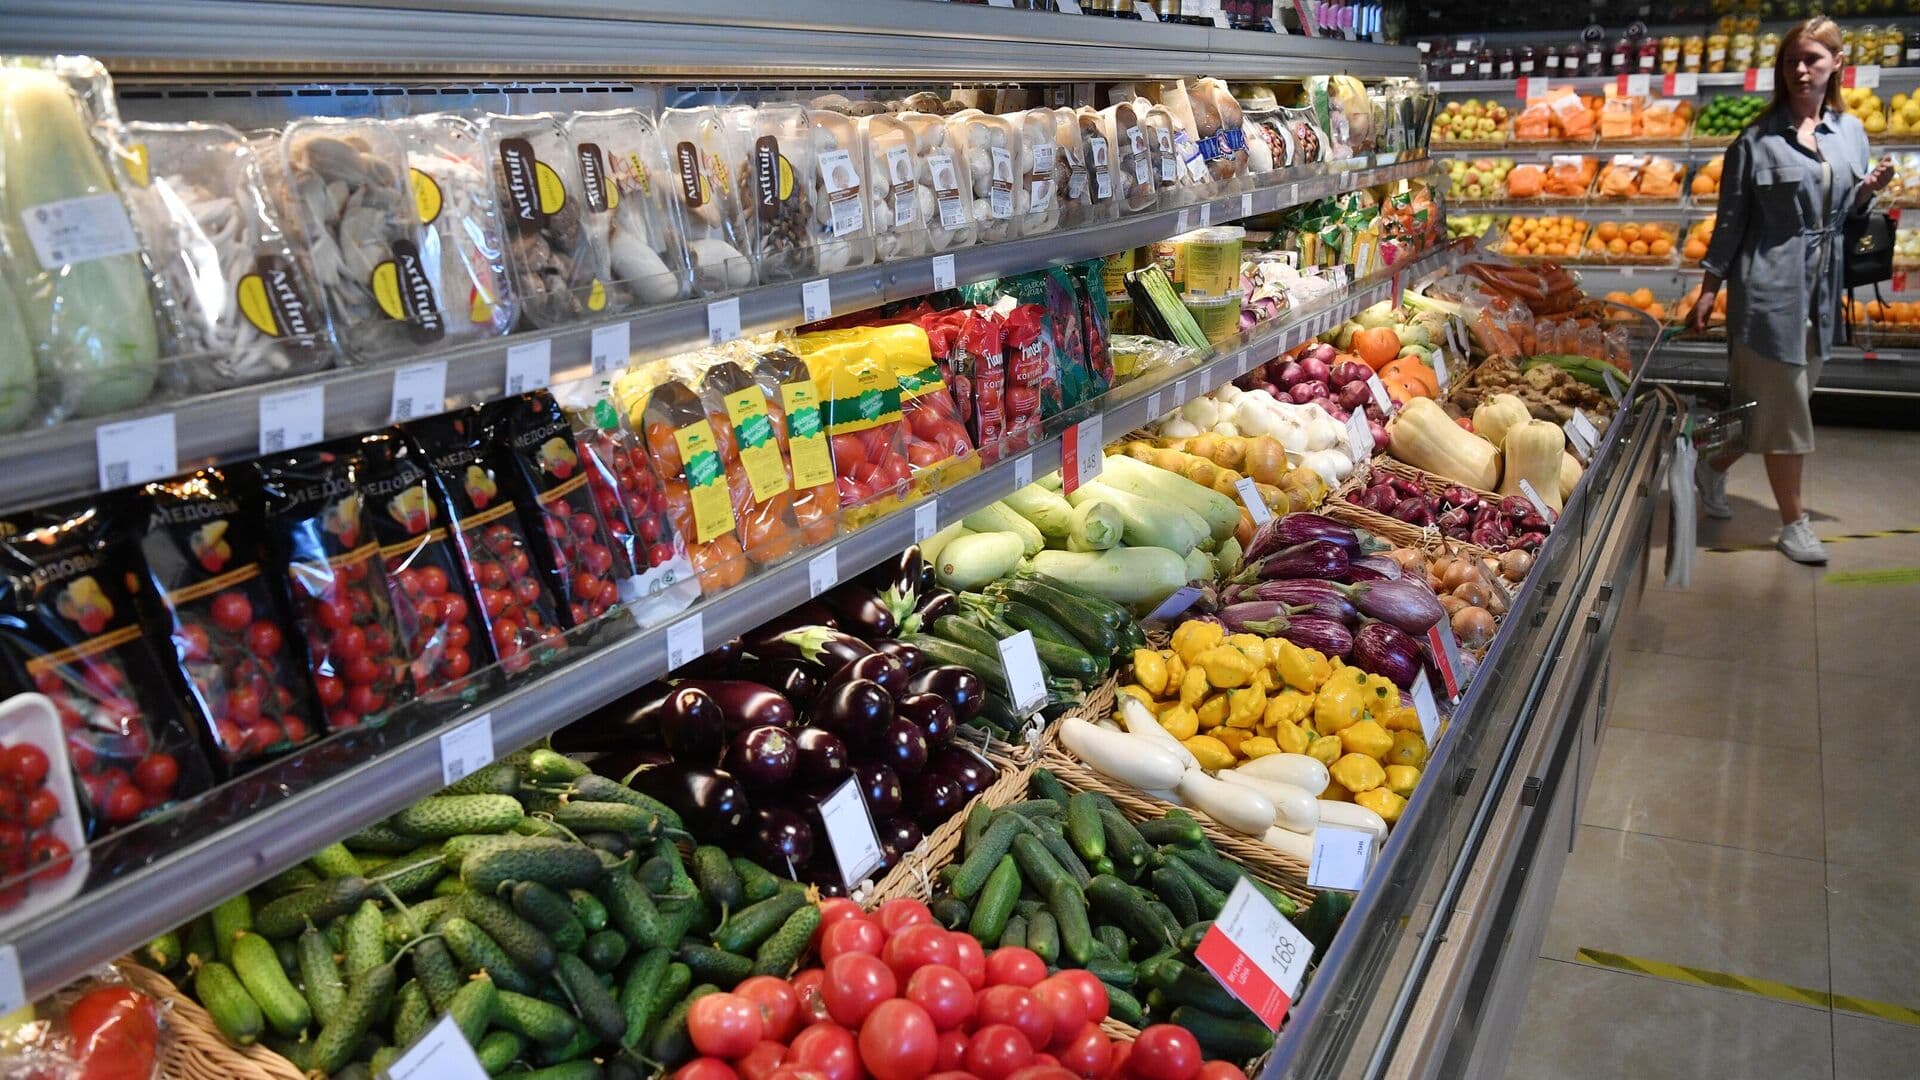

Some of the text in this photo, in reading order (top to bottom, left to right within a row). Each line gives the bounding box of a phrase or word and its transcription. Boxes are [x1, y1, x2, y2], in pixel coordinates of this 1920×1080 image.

[505, 149, 536, 220] Artfruit
[680, 149, 698, 199] Artfruit
[759, 146, 775, 206] Artfruit
[266, 268, 316, 348] Artfruit
[400, 254, 438, 331] Artfruit
[1271, 936, 1296, 974] 168
